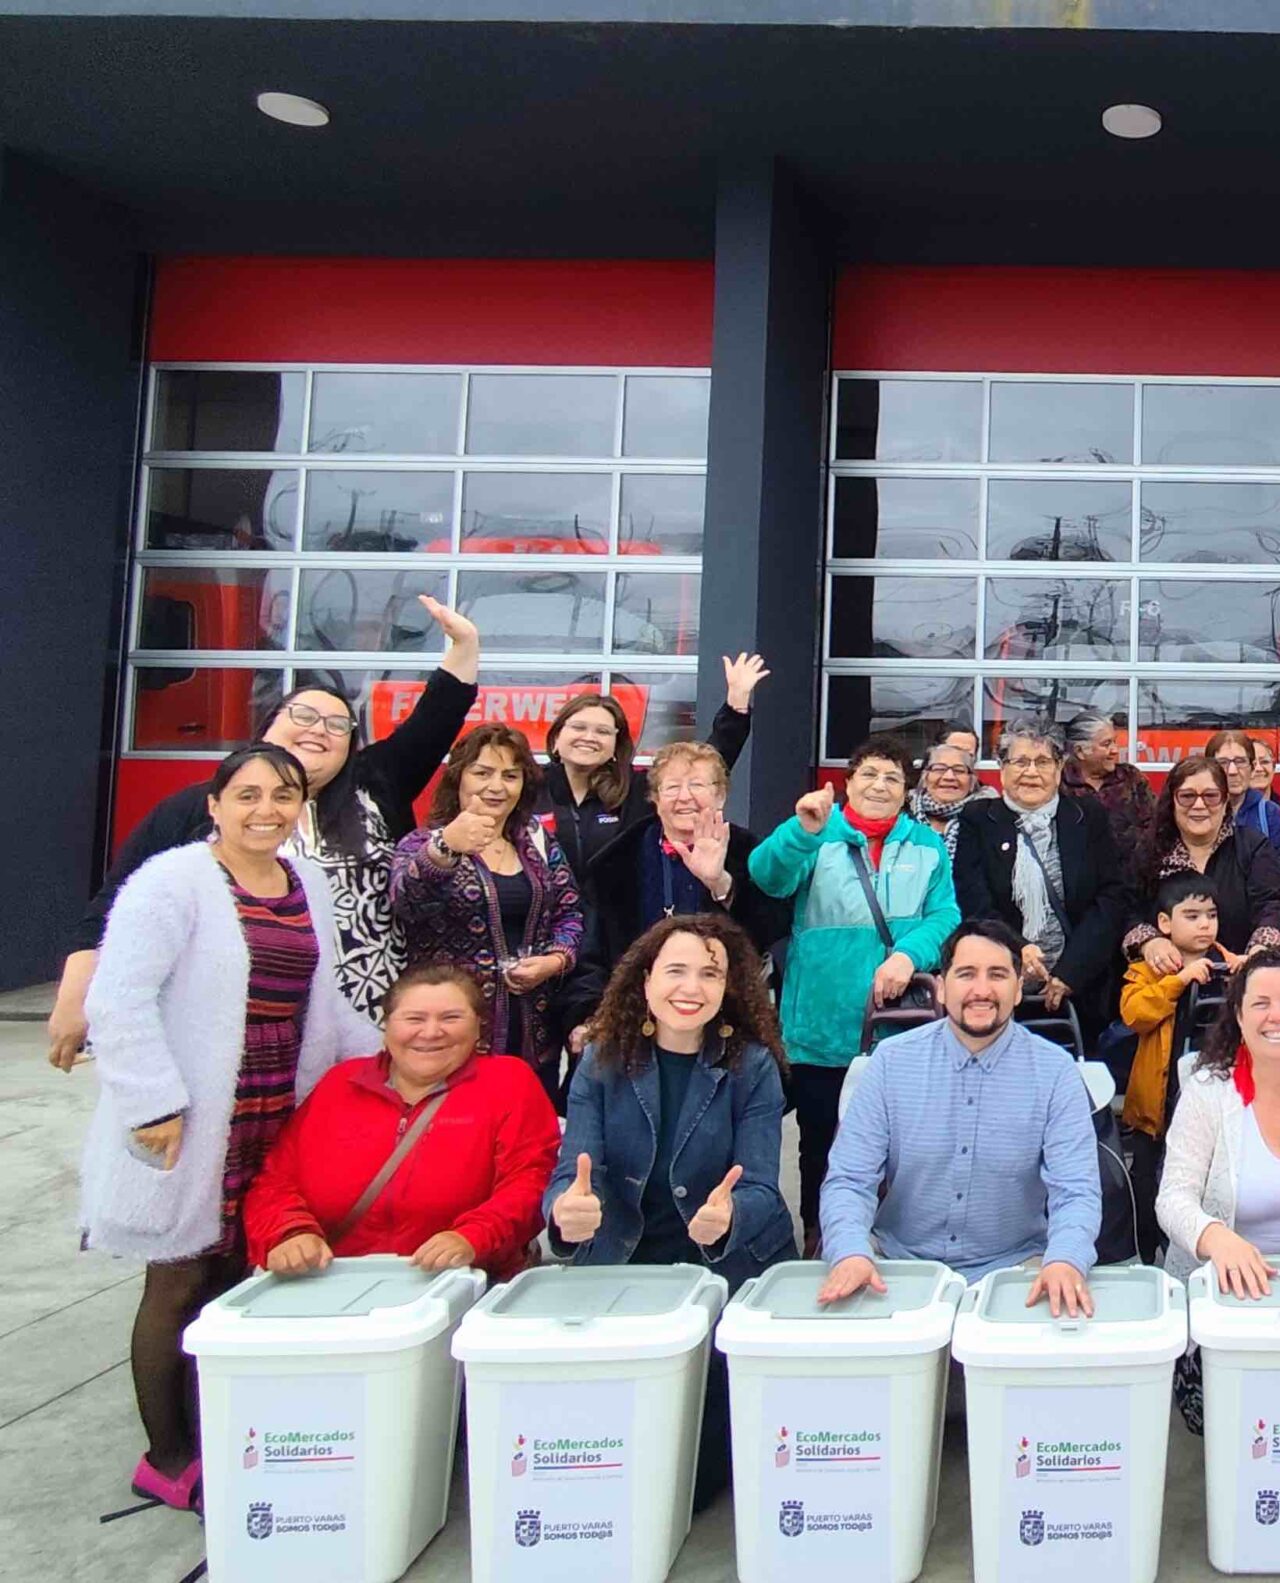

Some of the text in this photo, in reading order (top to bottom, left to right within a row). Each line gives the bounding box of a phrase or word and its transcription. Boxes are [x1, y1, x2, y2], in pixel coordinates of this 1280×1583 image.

[264, 1430, 355, 1444] EcoMercados
[796, 1430, 881, 1442] EcoMercados
[533, 1437, 623, 1451] EcoMercados
[1036, 1440, 1121, 1453] EcoMercados
[264, 1445, 333, 1457] Solidarios
[796, 1444, 861, 1456] Solidarios
[533, 1452, 602, 1464] Solidarios
[1036, 1455, 1101, 1466] Solidarios
[276, 1514, 346, 1524] PUERTO VARAS
[807, 1513, 872, 1522] PUERTO VARAS
[276, 1523, 346, 1533] SOMOS TOD@S
[544, 1521, 613, 1532] PUERTO VARAS
[807, 1522, 872, 1531] SOMOS TOD@S
[1047, 1522, 1112, 1531] PUERTO VARAS
[544, 1530, 613, 1541] SOMOS TOD@S
[1047, 1531, 1112, 1540] SOMOS TOD@S
